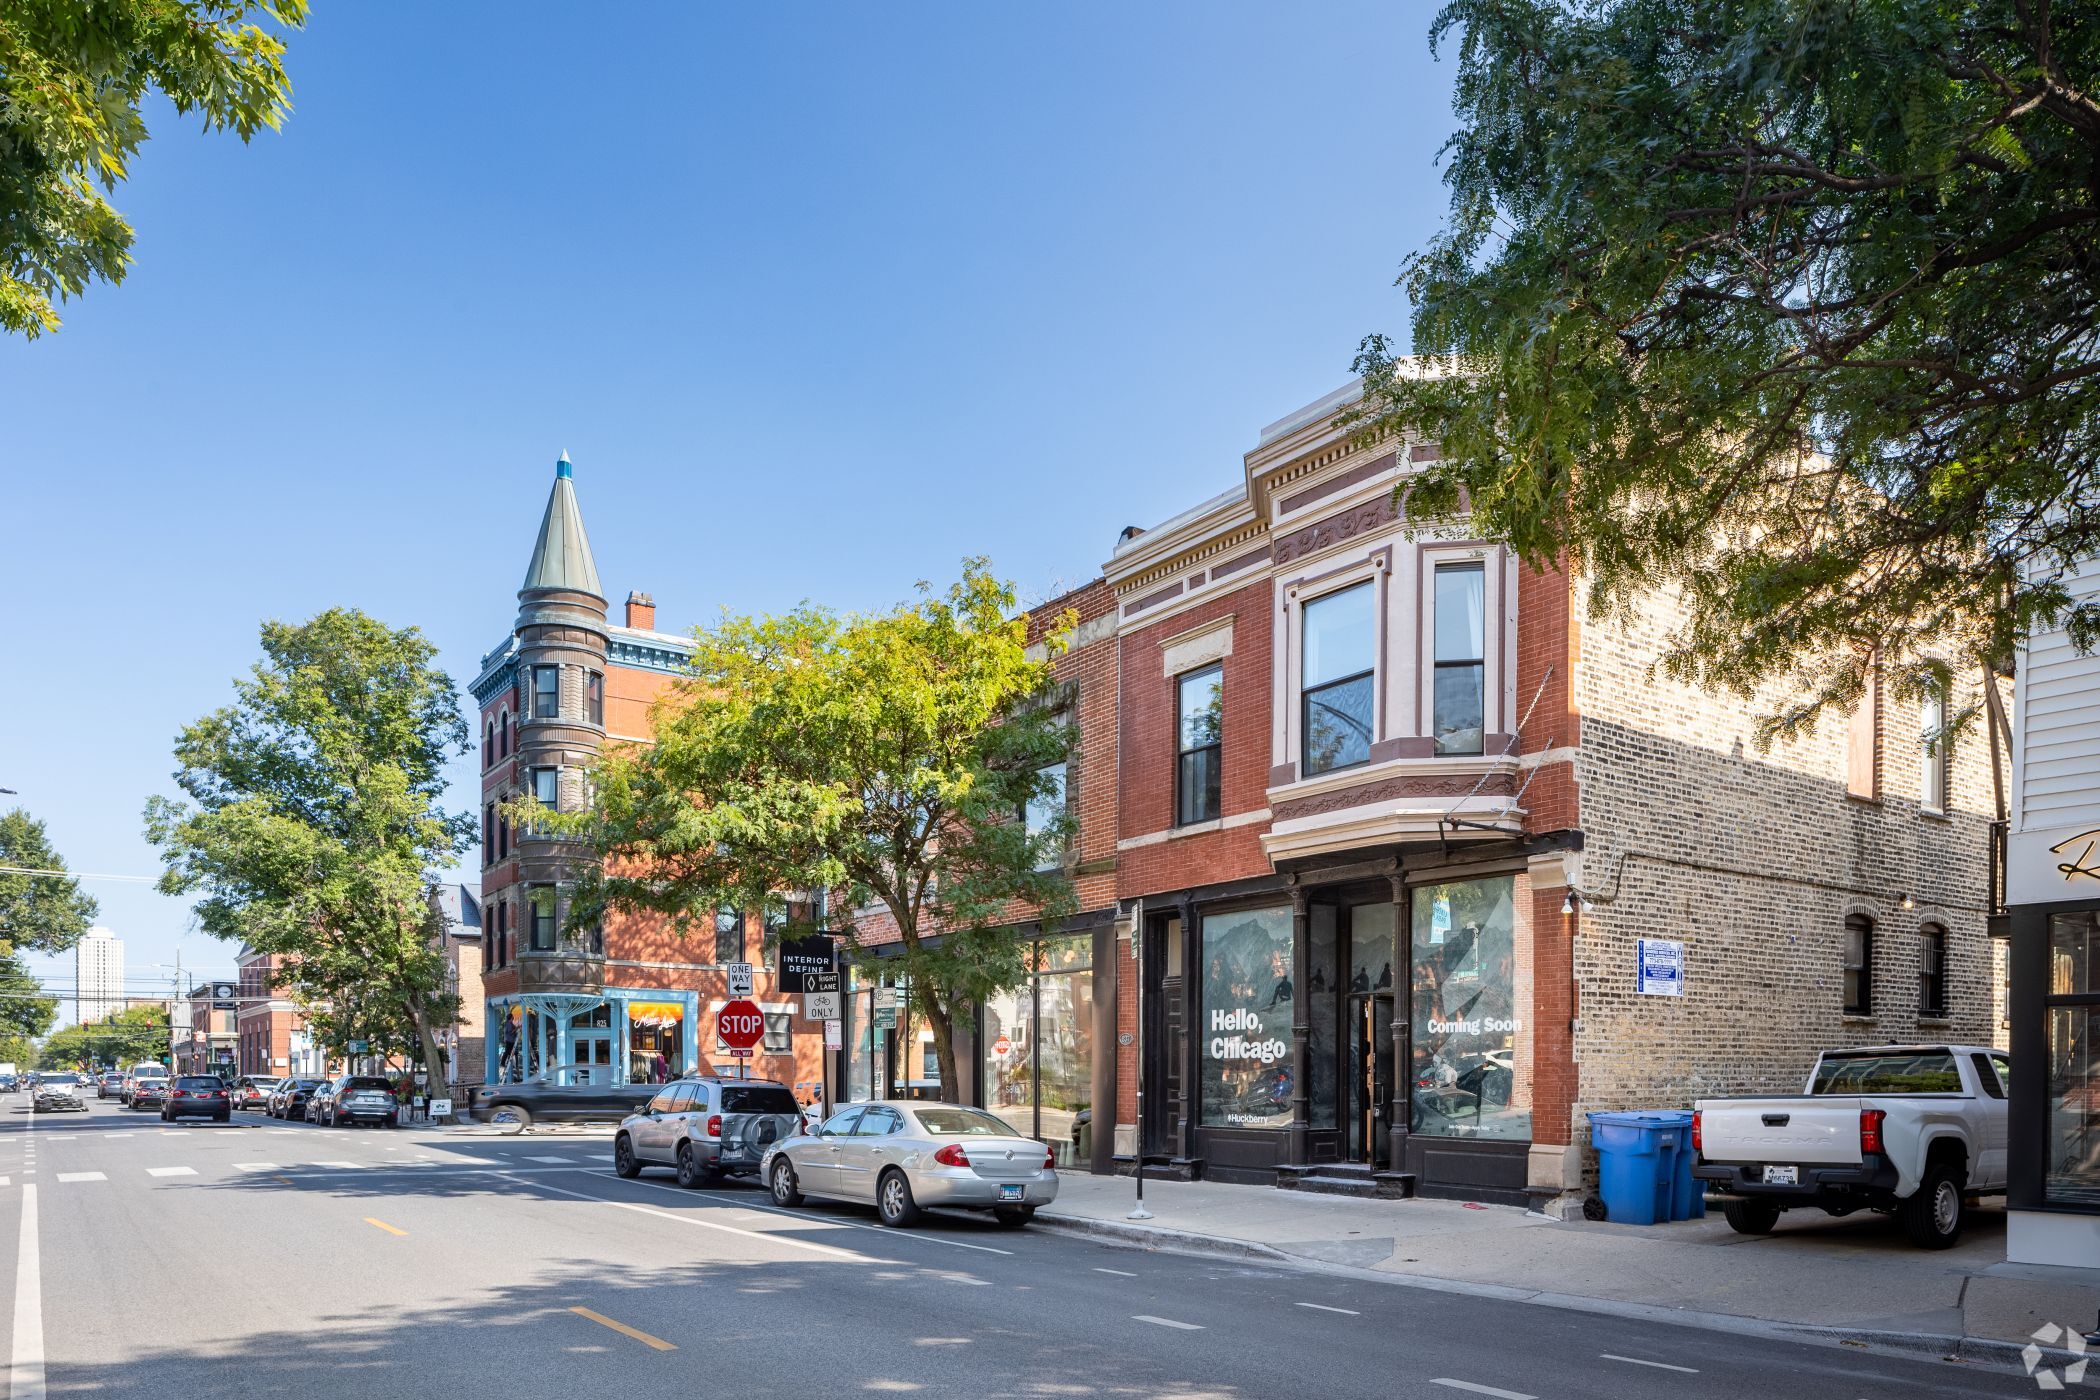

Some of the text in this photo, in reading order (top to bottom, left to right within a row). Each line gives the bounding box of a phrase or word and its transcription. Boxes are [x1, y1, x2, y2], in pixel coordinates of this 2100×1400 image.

[783, 955, 829, 965] INTERIOR
[731, 965, 750, 973] ONE
[788, 965, 824, 973] DEFINE
[731, 974, 750, 983] WAY
[818, 974, 837, 982] RIGHT
[811, 1007, 834, 1018] ONLY
[596, 1019, 607, 1027] 825
[720, 1015, 762, 1034] STOP
[1211, 1008, 1263, 1034] Hello,
[1427, 1017, 1522, 1036] Coming Soon
[1210, 1037, 1286, 1064] Chicago
[1227, 1113, 1268, 1126] #Huckberry
[1723, 1136, 1833, 1145] TACOMA
